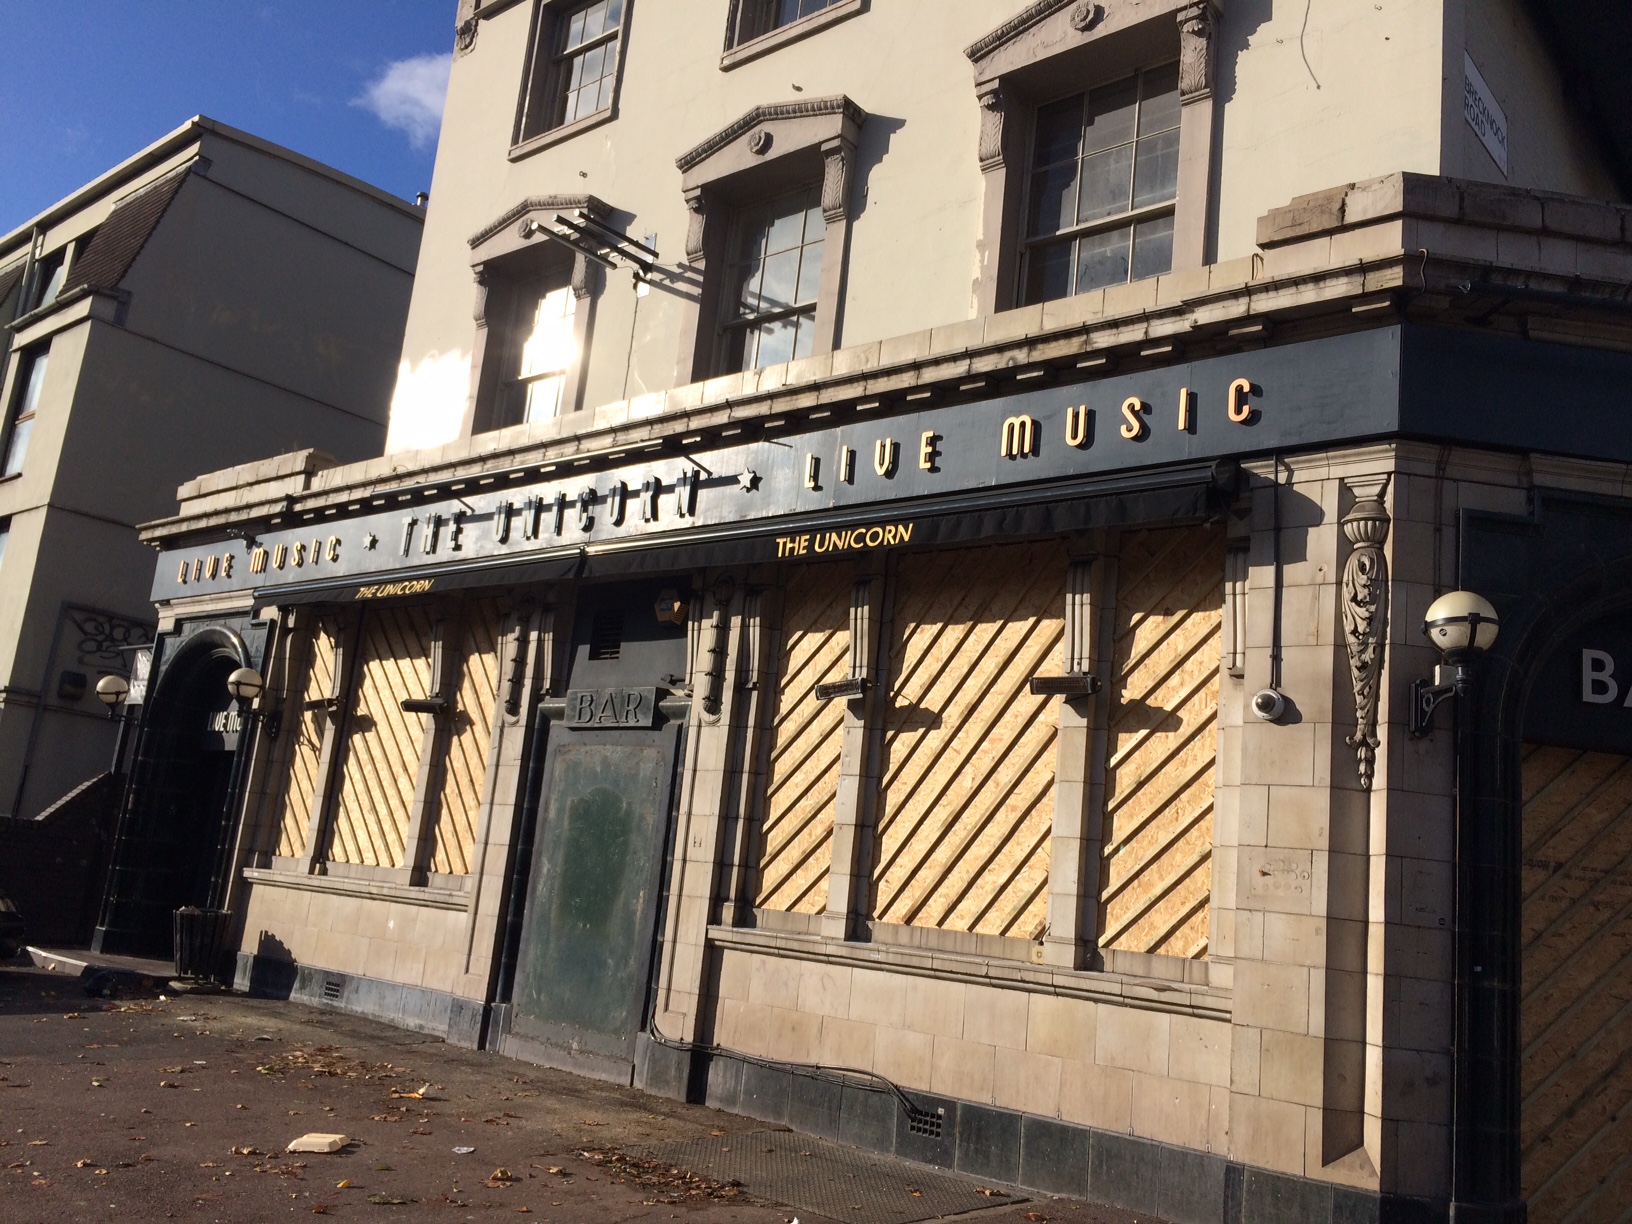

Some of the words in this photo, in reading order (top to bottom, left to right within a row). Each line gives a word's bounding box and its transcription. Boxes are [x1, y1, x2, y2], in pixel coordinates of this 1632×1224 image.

[1464, 75, 1505, 151] BRECKNOCK
[1464, 94, 1485, 137] ROAD
[803, 430, 938, 489] LIVE
[1000, 377, 1256, 458] MUSIC
[401, 509, 467, 556] THE
[493, 467, 699, 543] UNICORN
[177, 552, 232, 583] LIVE
[250, 535, 338, 573] MUSIC
[775, 534, 810, 558] THE
[814, 523, 914, 552] UNICORN
[355, 585, 379, 599] THE
[376, 579, 434, 597] UNICORN
[1582, 648, 1632, 708] B
[574, 691, 642, 724] BAR
